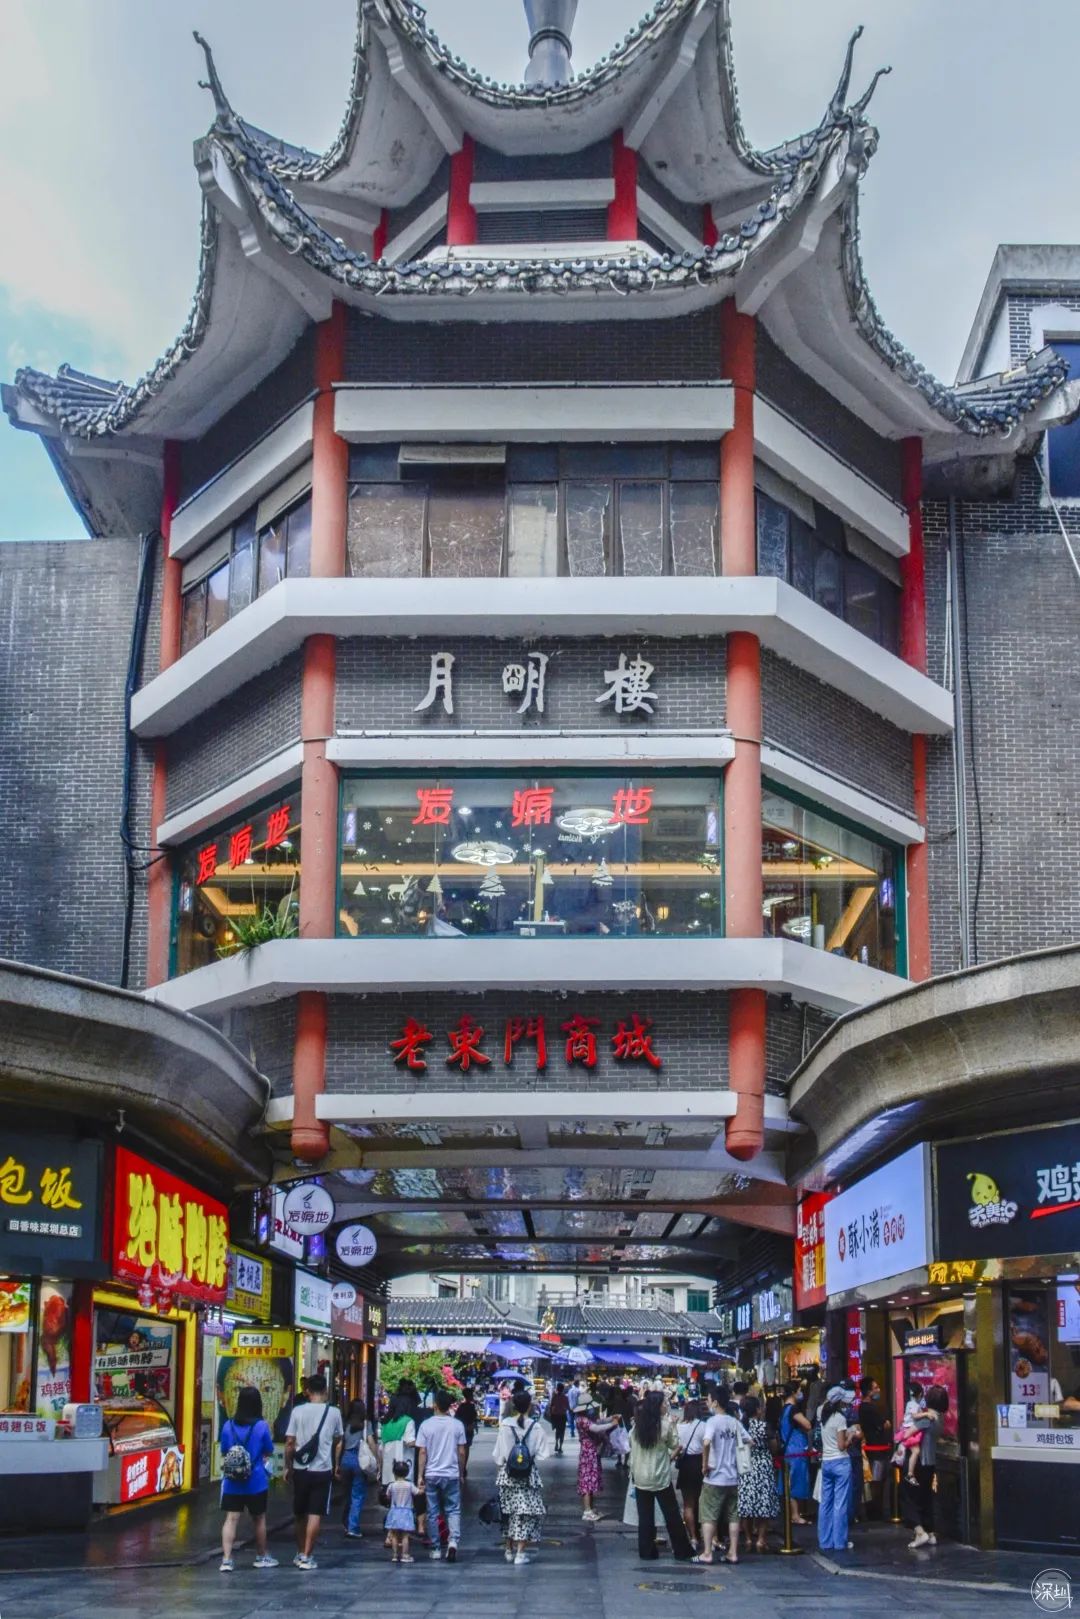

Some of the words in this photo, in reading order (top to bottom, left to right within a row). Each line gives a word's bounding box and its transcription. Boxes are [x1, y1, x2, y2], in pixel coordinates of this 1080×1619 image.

[127, 1172, 228, 1289] 绝味鸭脖
[1022, 1384, 1036, 1397] 13
[1036, 1433, 1075, 1446] 鸡翅包饭
